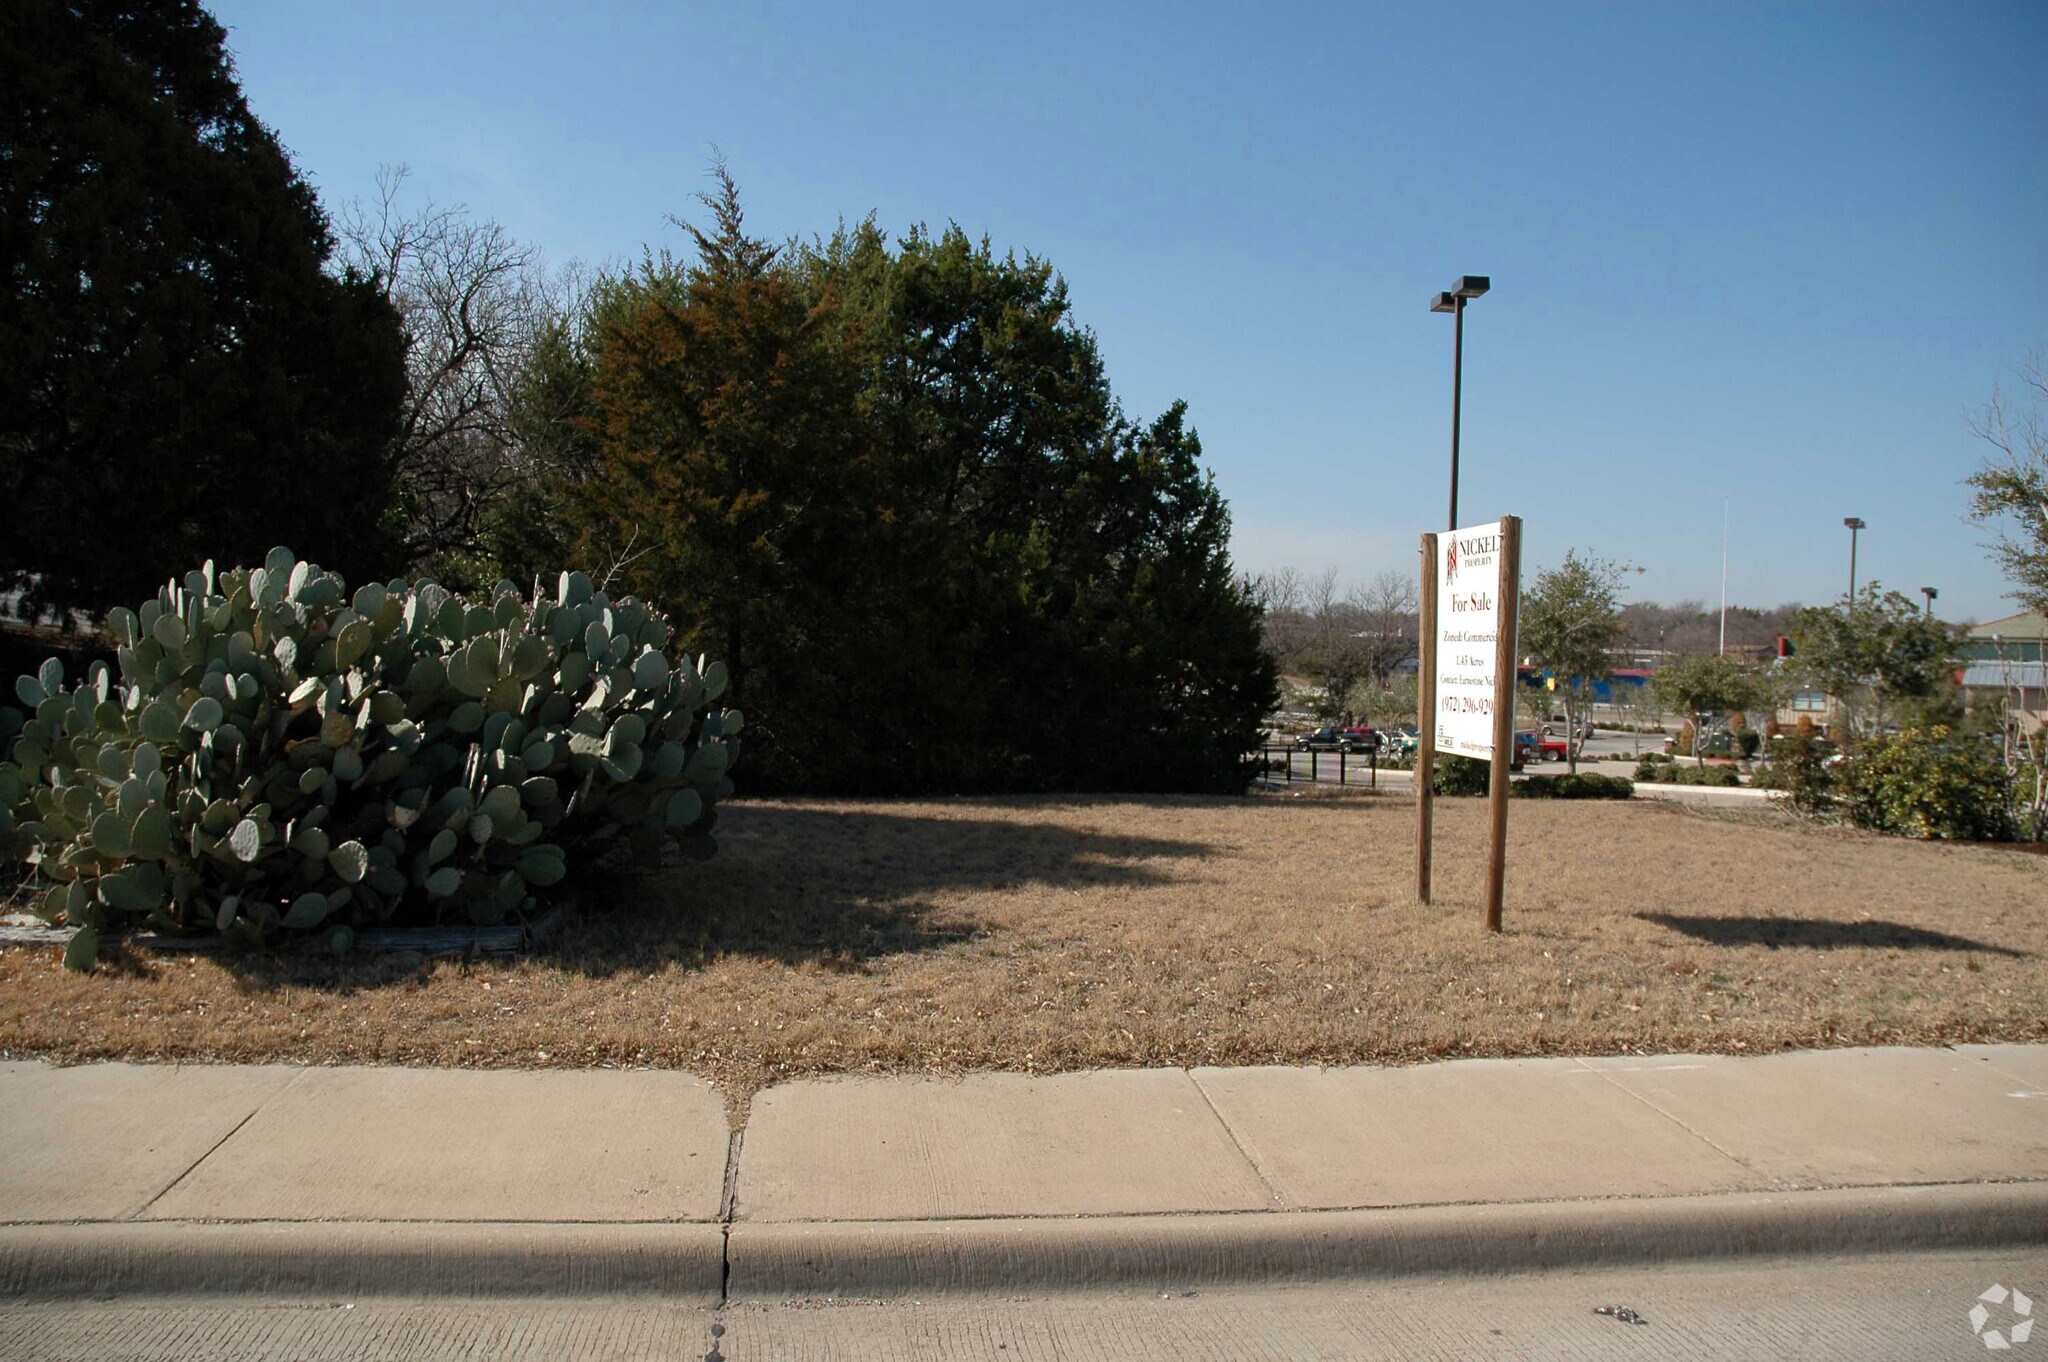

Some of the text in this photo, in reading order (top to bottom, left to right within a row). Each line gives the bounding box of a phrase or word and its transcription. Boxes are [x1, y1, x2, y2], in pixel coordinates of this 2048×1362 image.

[1459, 535, 1499, 556] NICKEL
[1464, 556, 1492, 568] PROPERTY
[1452, 592, 1492, 612] For Sale
[1441, 696, 1494, 716] (972) 296-929
